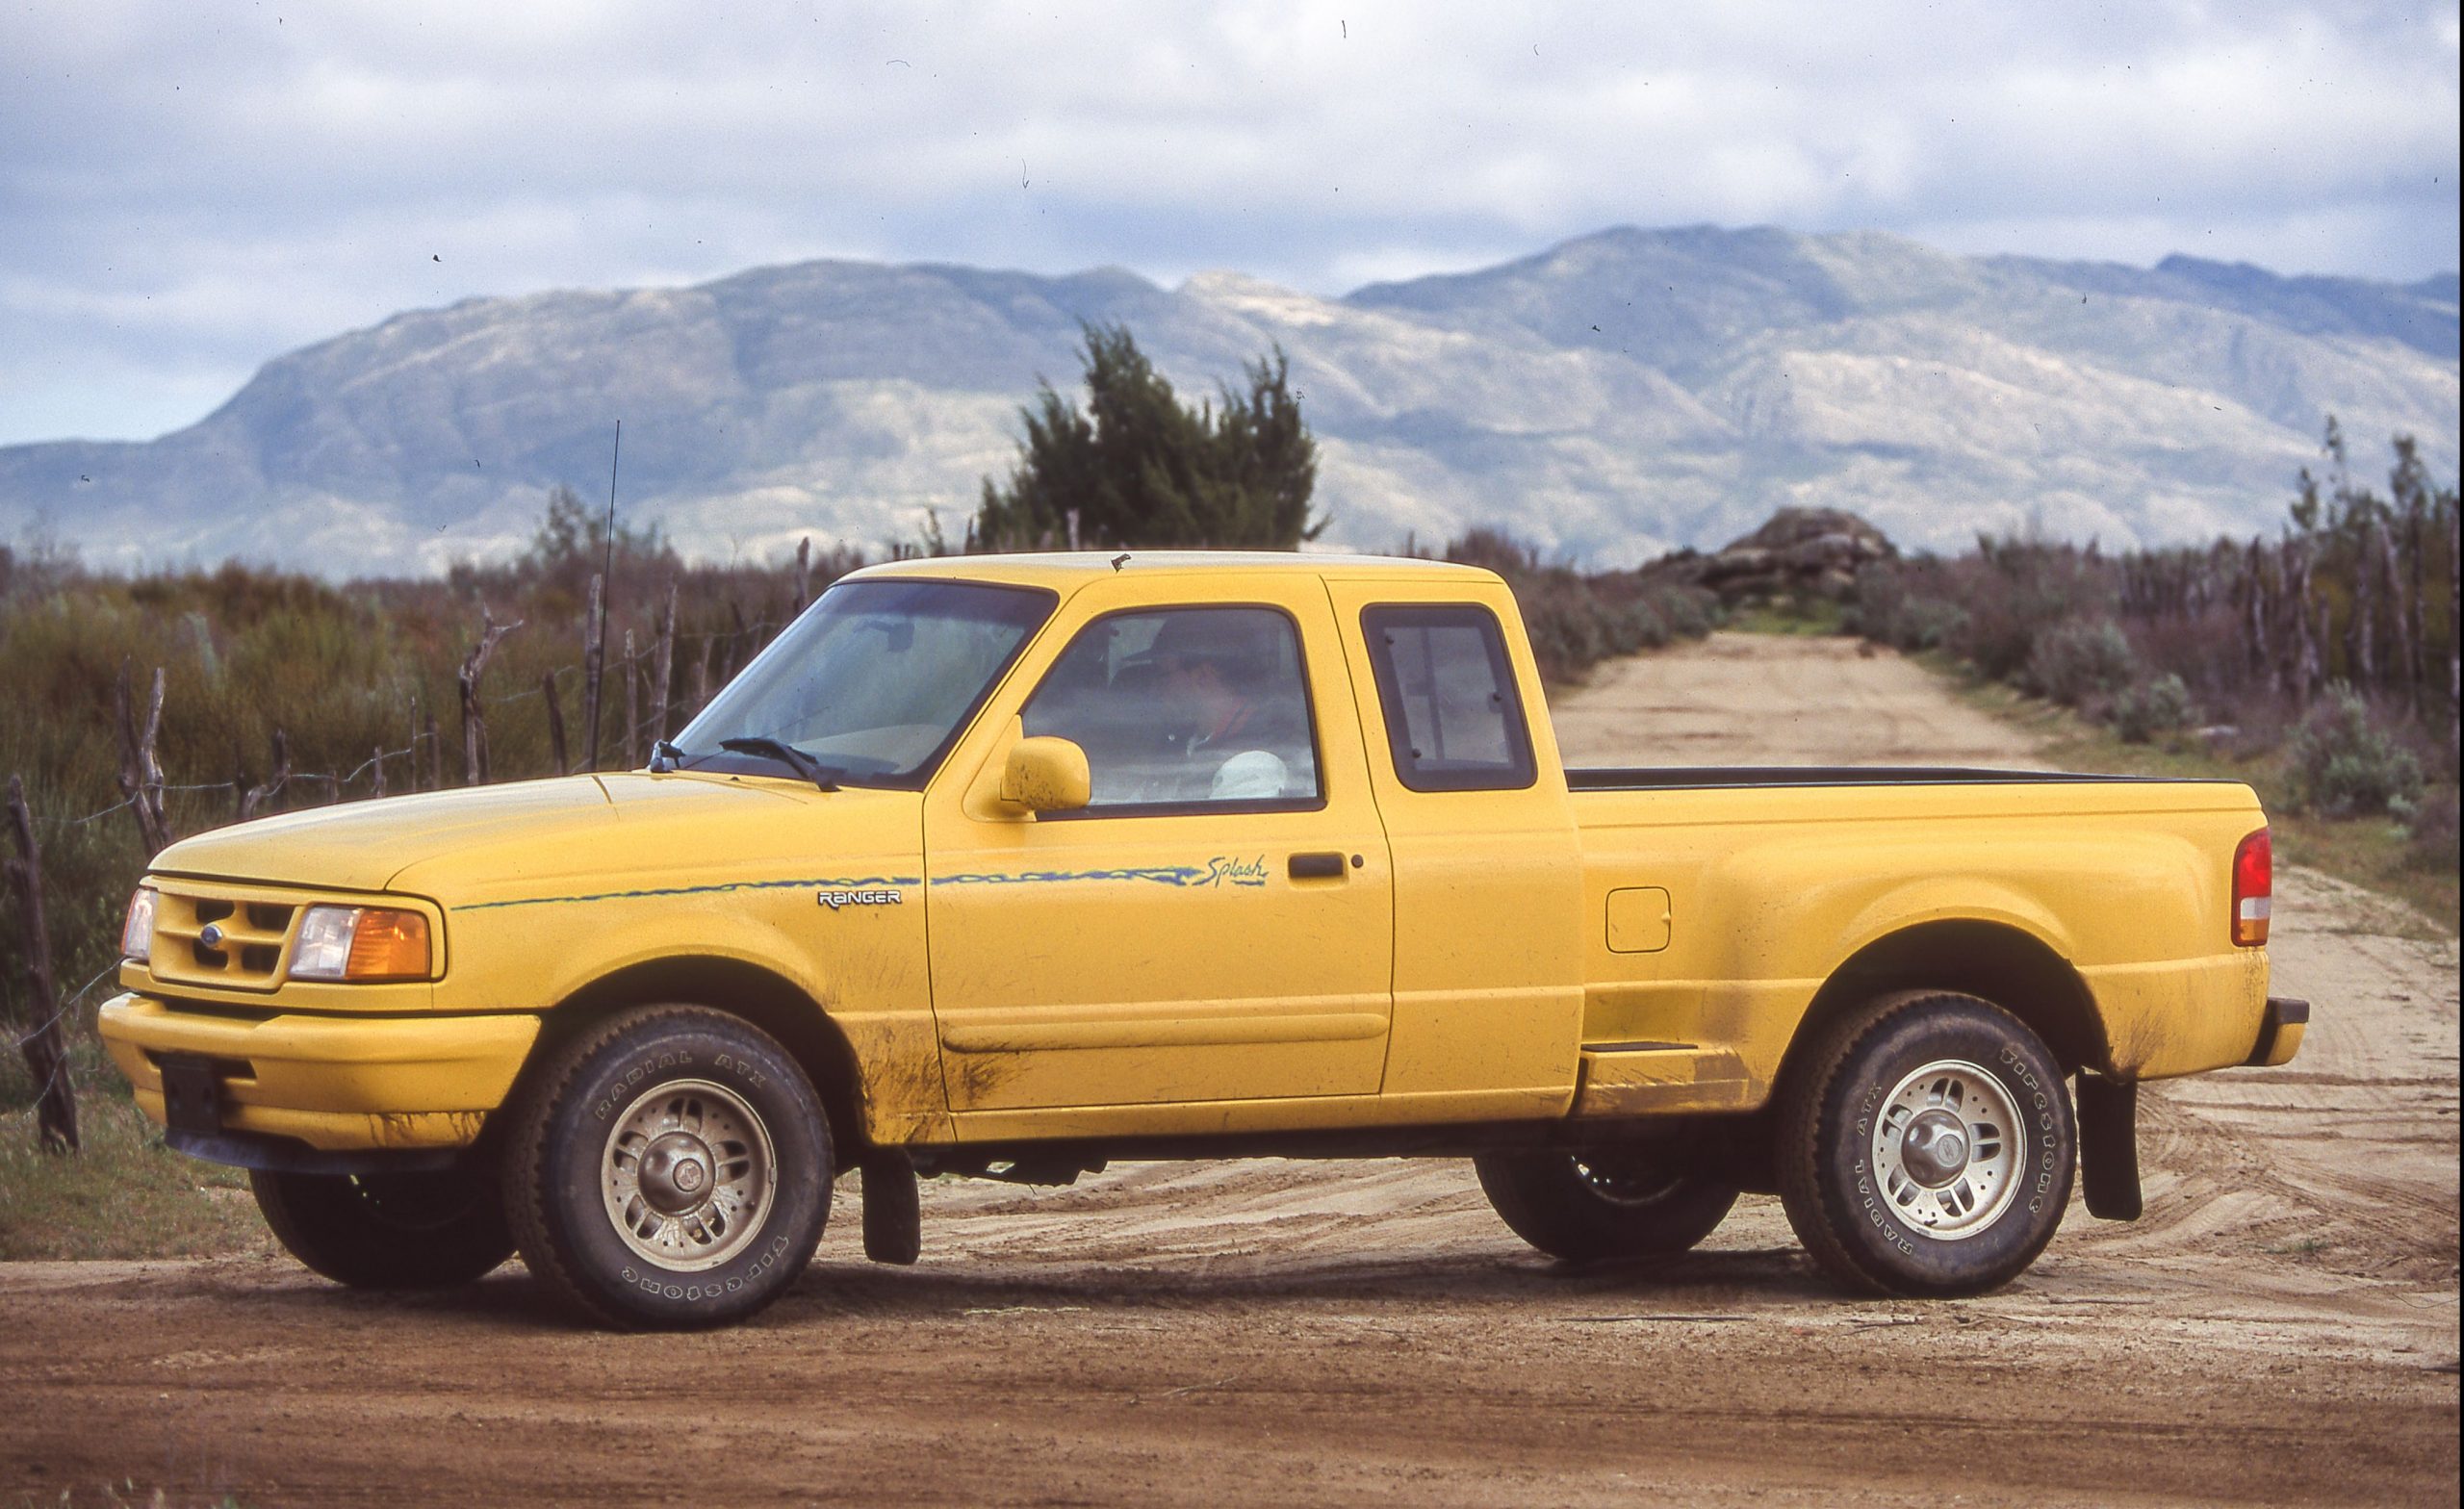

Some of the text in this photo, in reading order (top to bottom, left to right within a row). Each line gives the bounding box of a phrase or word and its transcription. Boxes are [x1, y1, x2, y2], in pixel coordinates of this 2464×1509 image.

[1192, 854, 1270, 887] Splash
[595, 1051, 768, 1121] RADIAL ATX
[1854, 1082, 1913, 1254] RADIAL ATX
